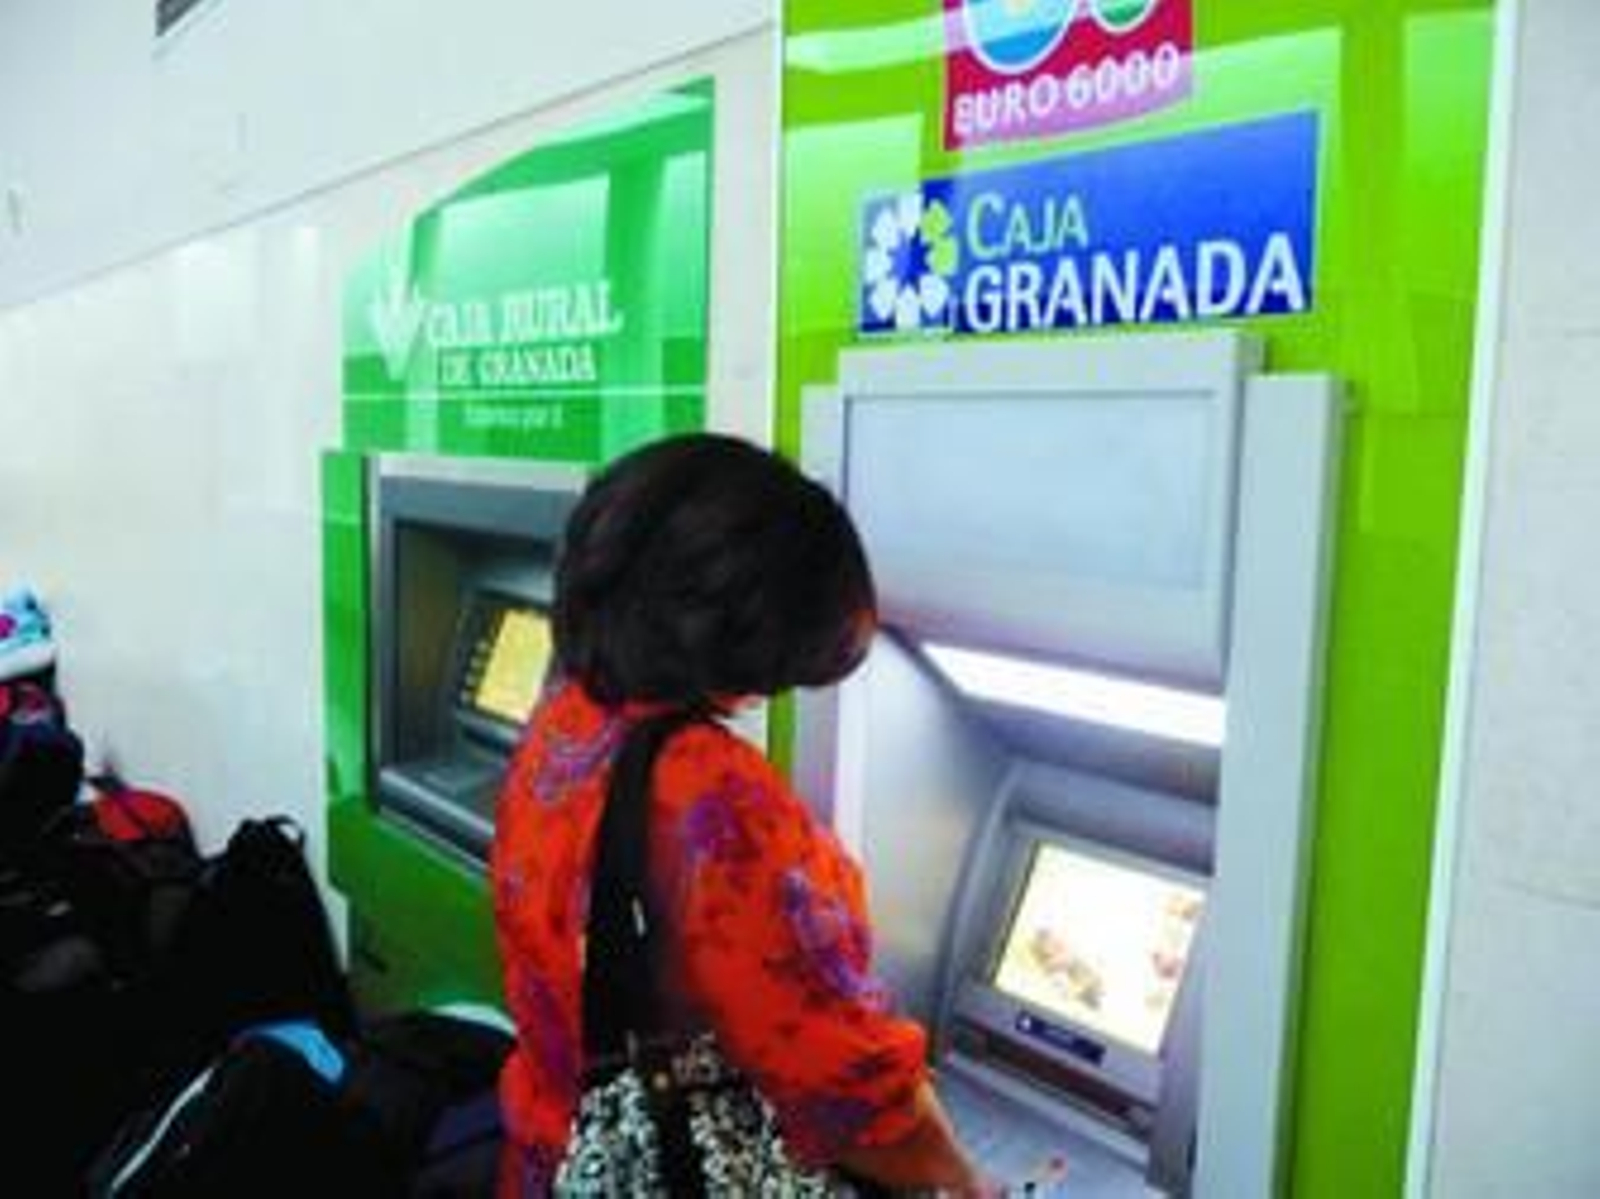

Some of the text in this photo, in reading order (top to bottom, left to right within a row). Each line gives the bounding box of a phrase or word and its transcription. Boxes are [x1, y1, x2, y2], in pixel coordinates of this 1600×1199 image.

[966, 191, 1088, 261] CAJA
[425, 280, 622, 348] CAJA RURAL
[964, 231, 1305, 334] GRANADA
[440, 343, 597, 387] DE GRANADA
